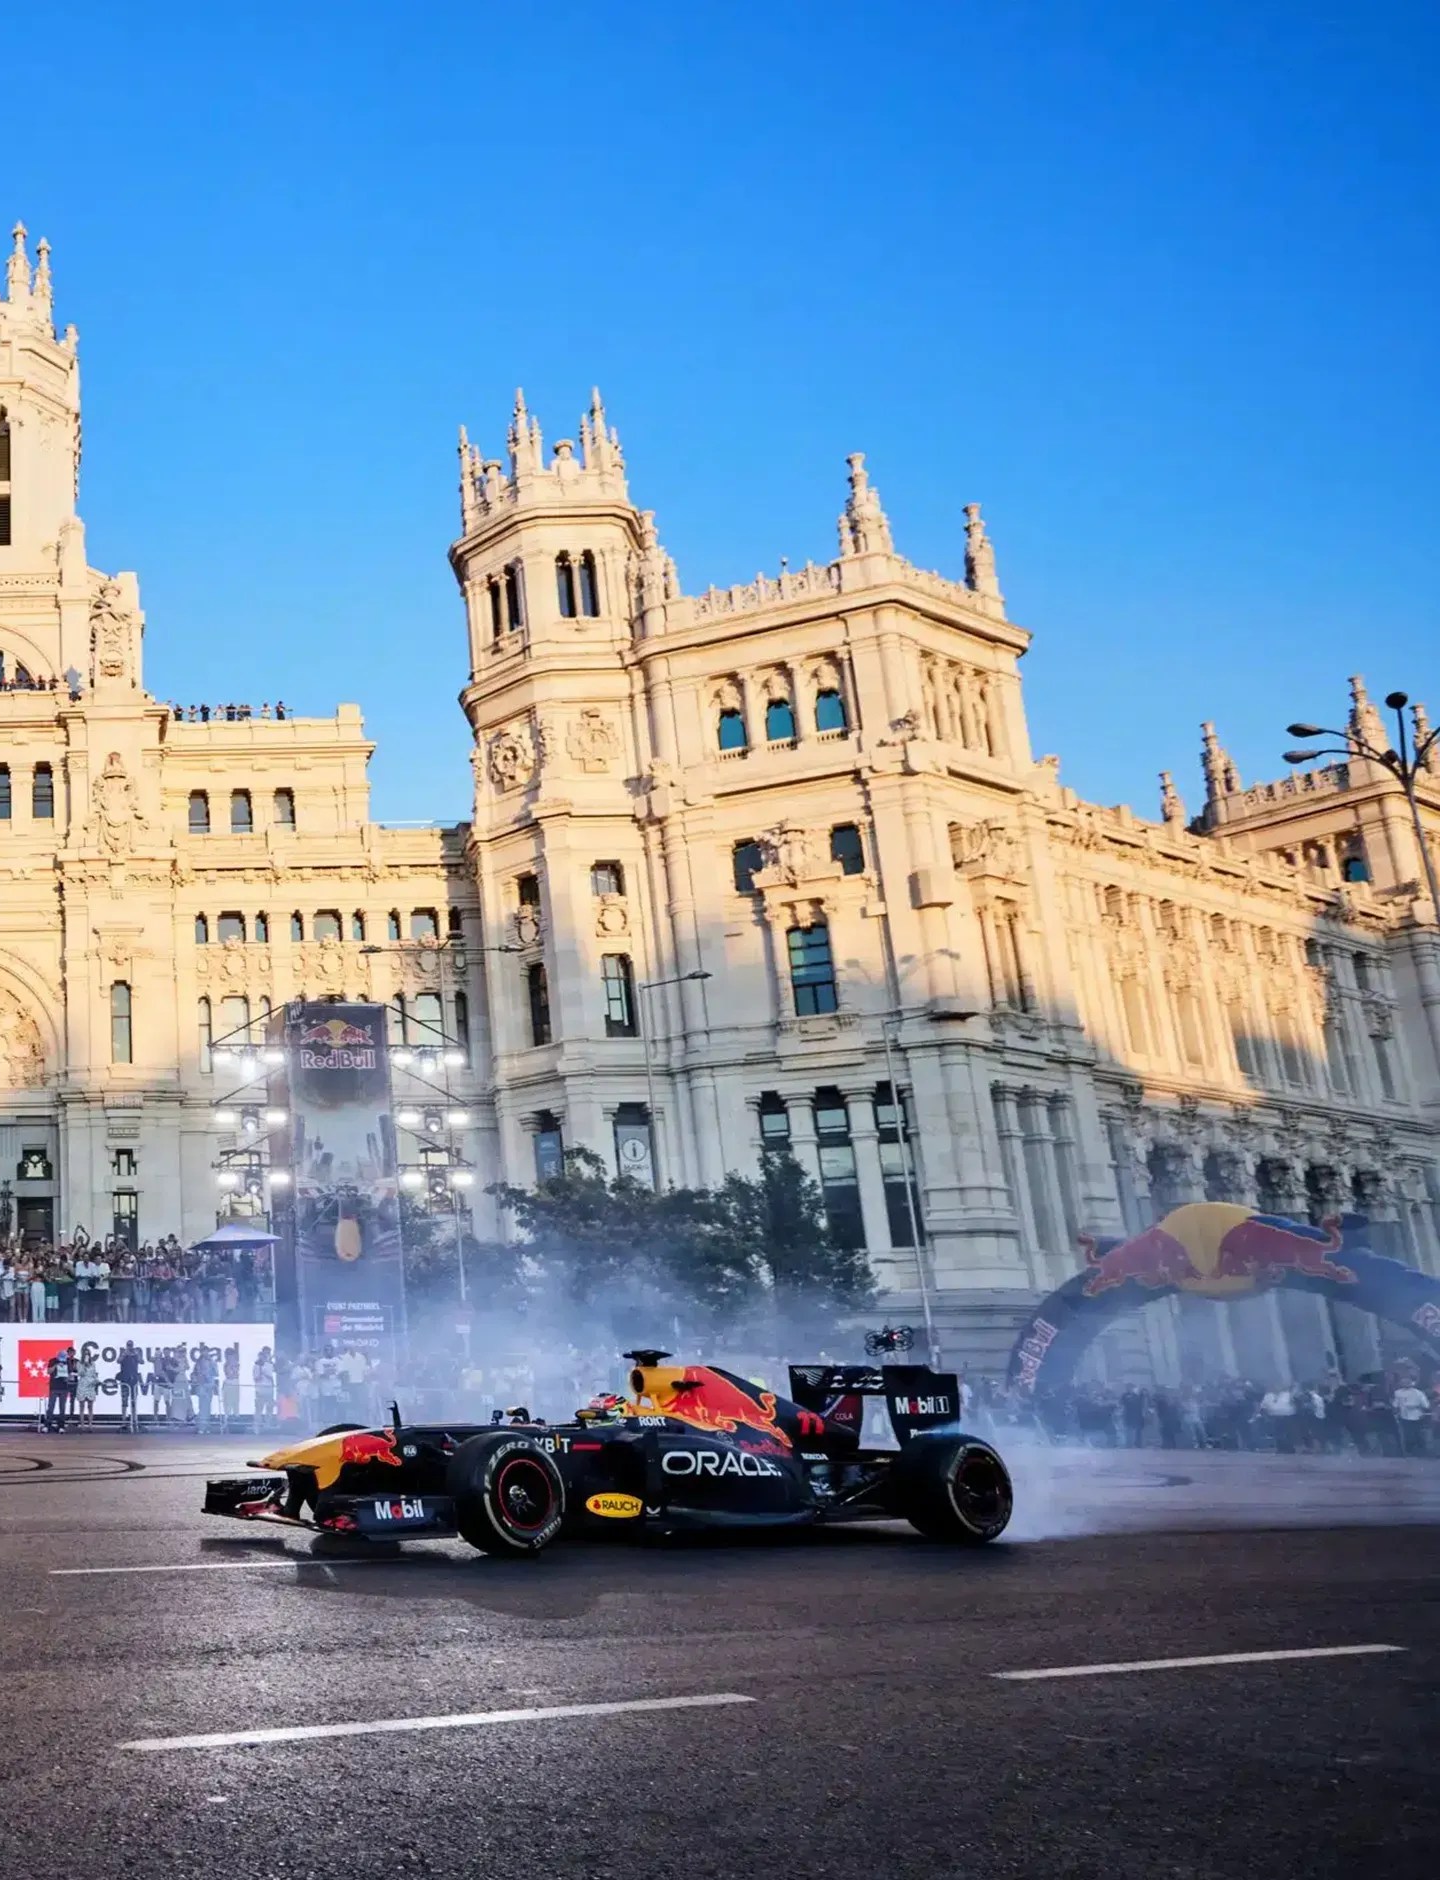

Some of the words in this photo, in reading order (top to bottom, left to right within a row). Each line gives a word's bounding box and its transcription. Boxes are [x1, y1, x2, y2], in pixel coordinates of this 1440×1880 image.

[895, 1396, 935, 1415] Mobil
[534, 1434, 571, 1454] YBIT
[662, 1451, 782, 1477] ORACLE
[375, 1499, 425, 1521] Mobil
[602, 1499, 640, 1512] RAUCH
